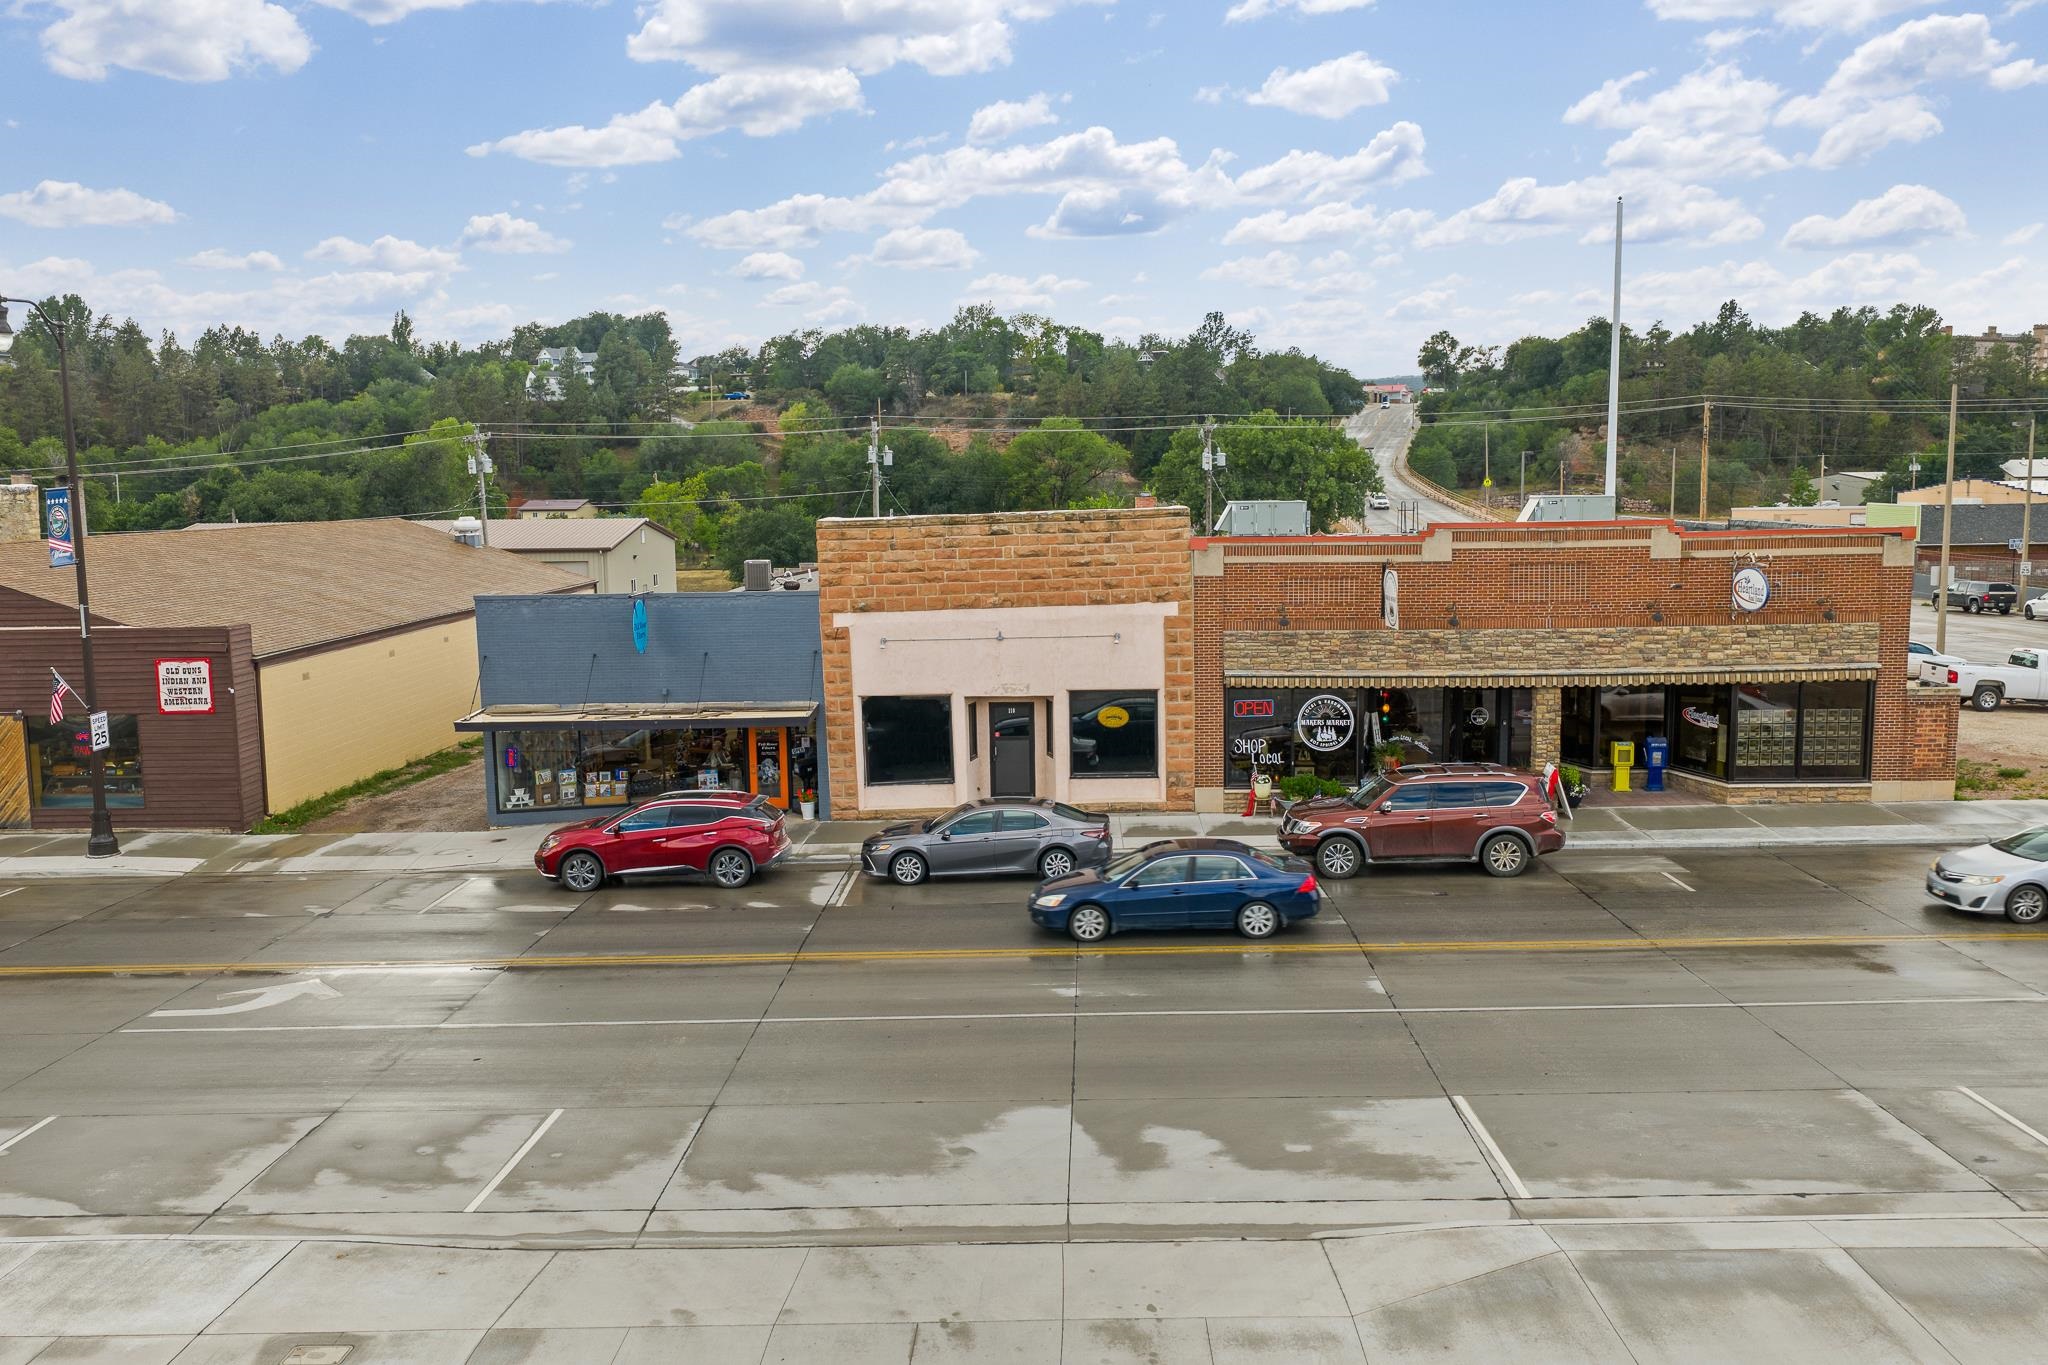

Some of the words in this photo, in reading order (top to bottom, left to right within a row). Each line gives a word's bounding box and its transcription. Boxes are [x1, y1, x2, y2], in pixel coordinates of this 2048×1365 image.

[1737, 582, 1764, 597] Heartland
[165, 667, 180, 675] OLD
[182, 667, 202, 675] GUNS
[162, 677, 189, 685] INDIAN
[191, 677, 207, 685] AND
[167, 687, 203, 695] WESTERN
[164, 697, 208, 706] AMERICANA
[1235, 701, 1273, 716] OPEN
[92, 716, 107, 725] SPEED
[1301, 719, 1325, 727] MAKERS
[1325, 719, 1351, 727] MARKET
[94, 731, 108, 746] 25
[1234, 738, 1267, 754] SHOP
